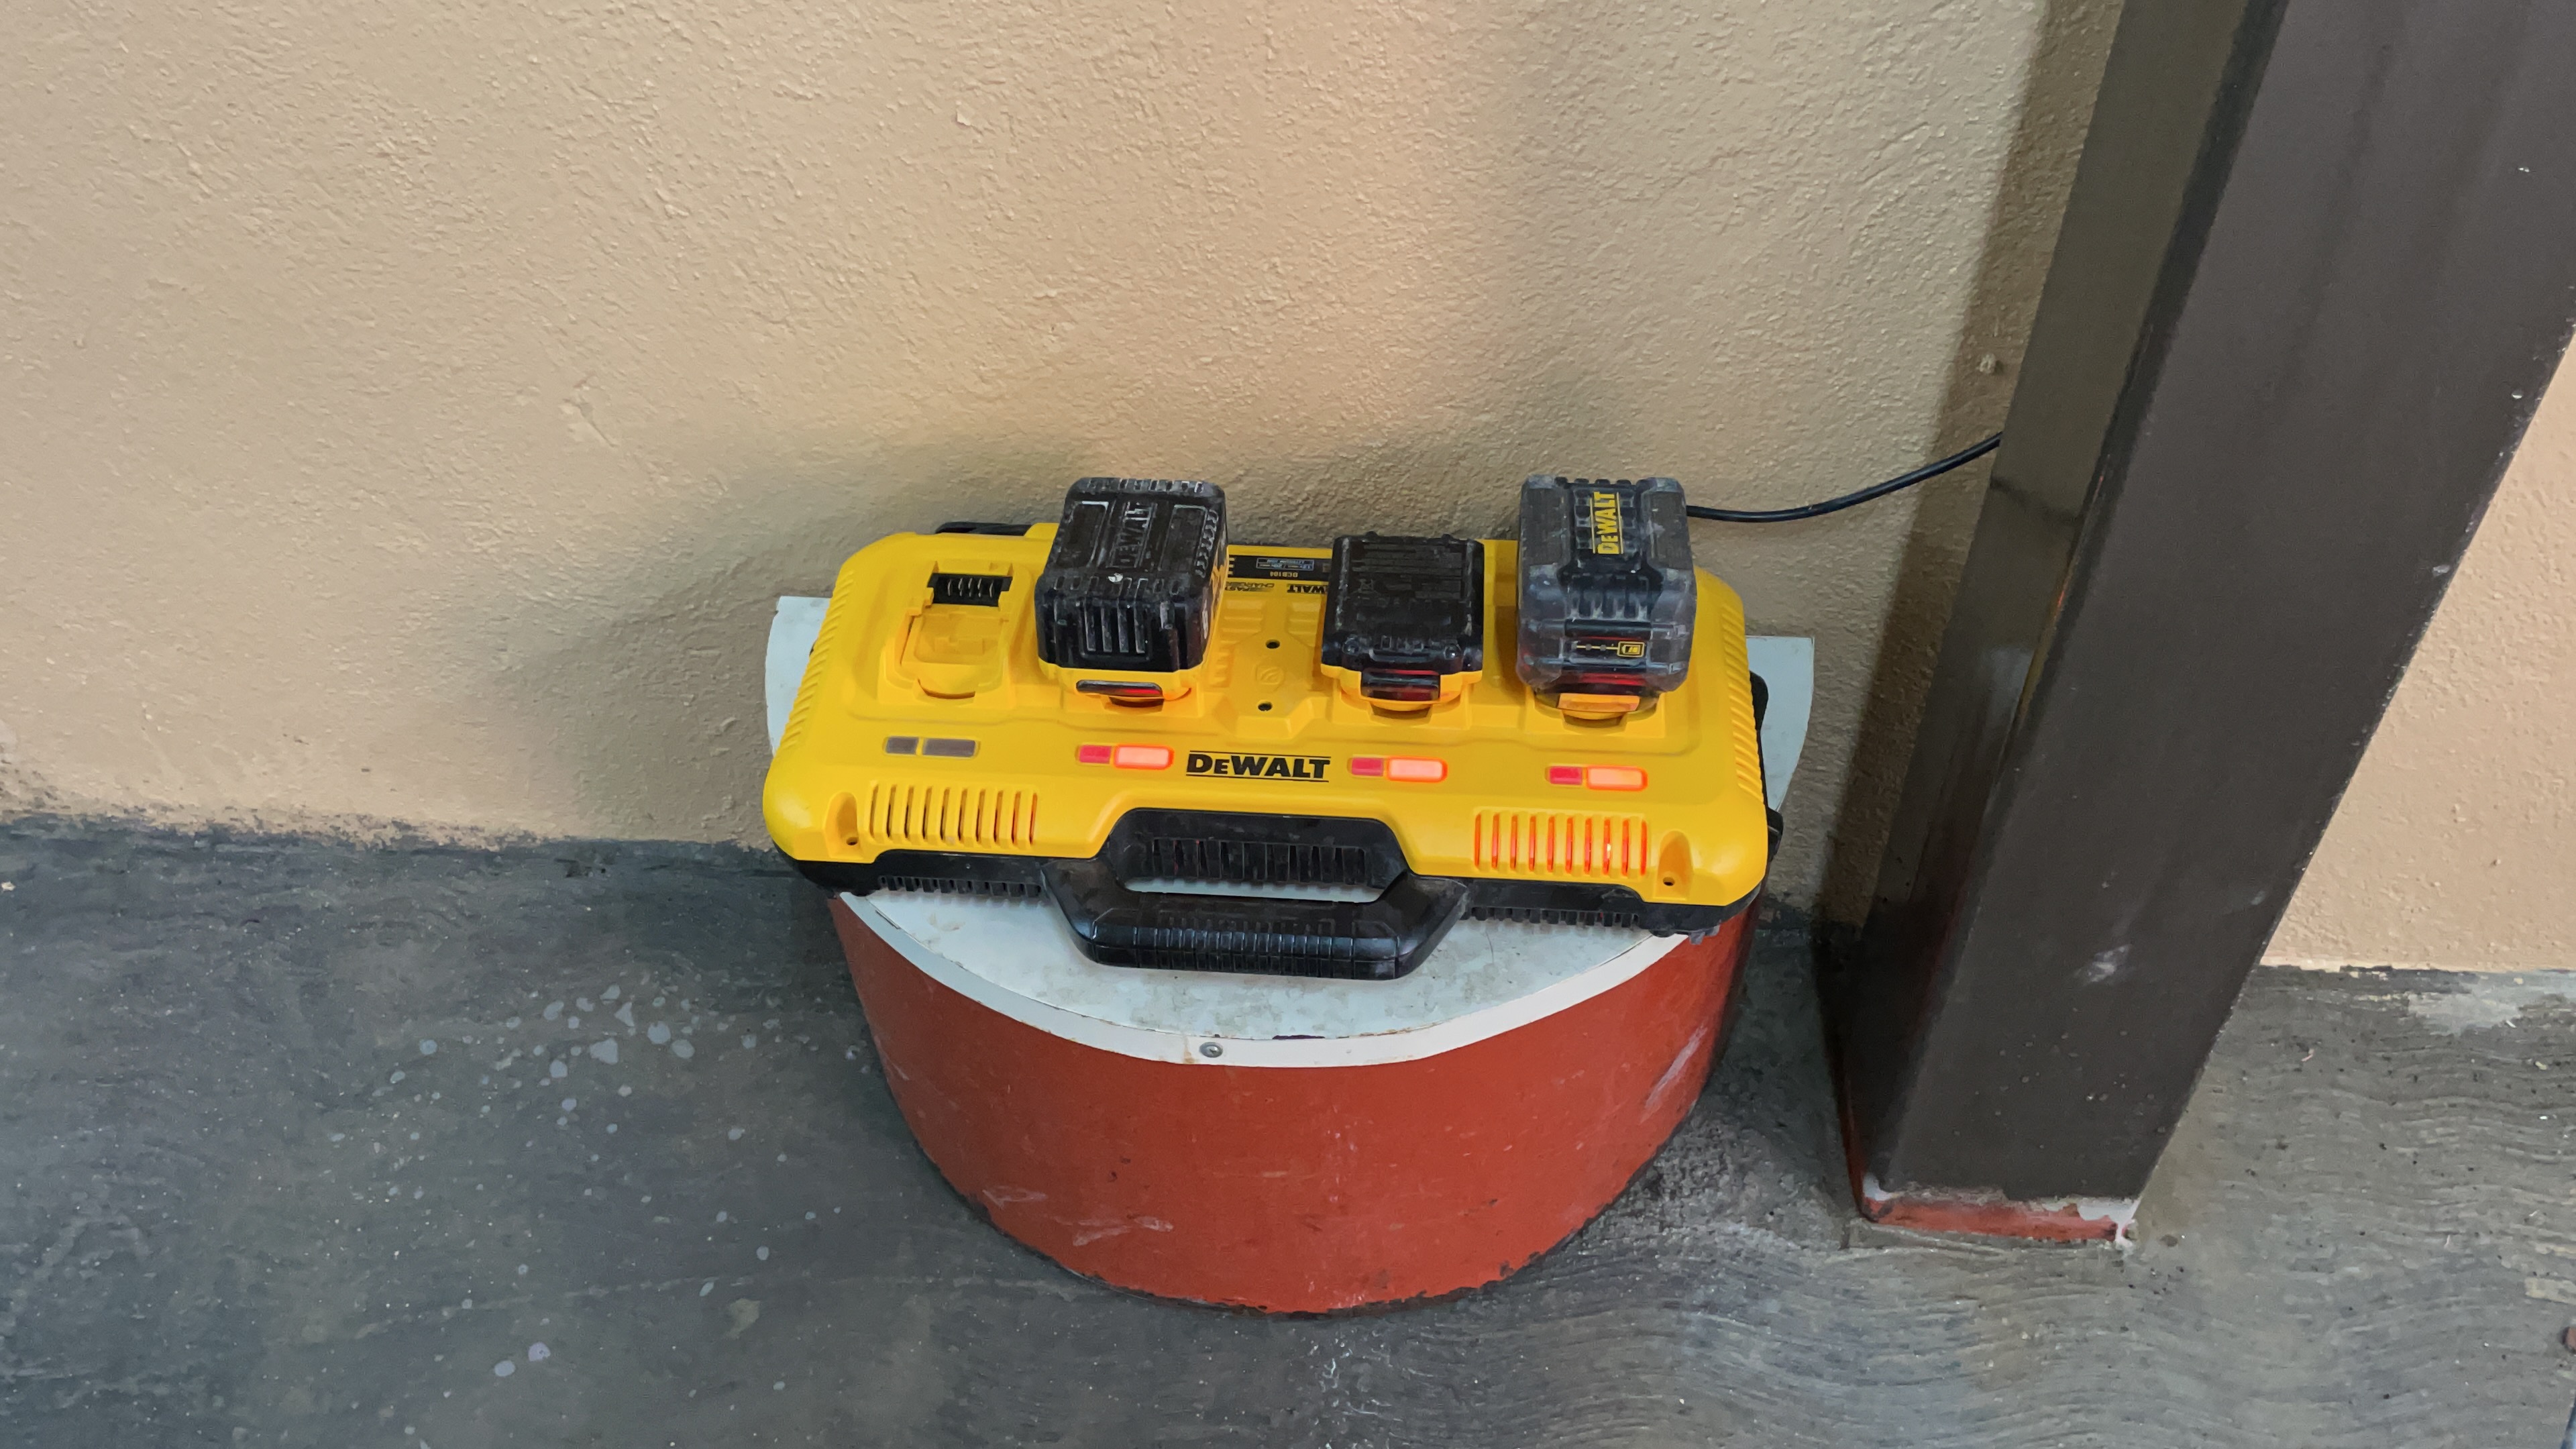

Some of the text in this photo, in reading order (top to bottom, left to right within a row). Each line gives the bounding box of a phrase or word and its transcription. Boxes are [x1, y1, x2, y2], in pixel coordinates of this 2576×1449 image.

[1594, 492, 1619, 554] DEWALT
[1287, 584, 1326, 594] WALT
[1186, 753, 1331, 779] DEWALT
